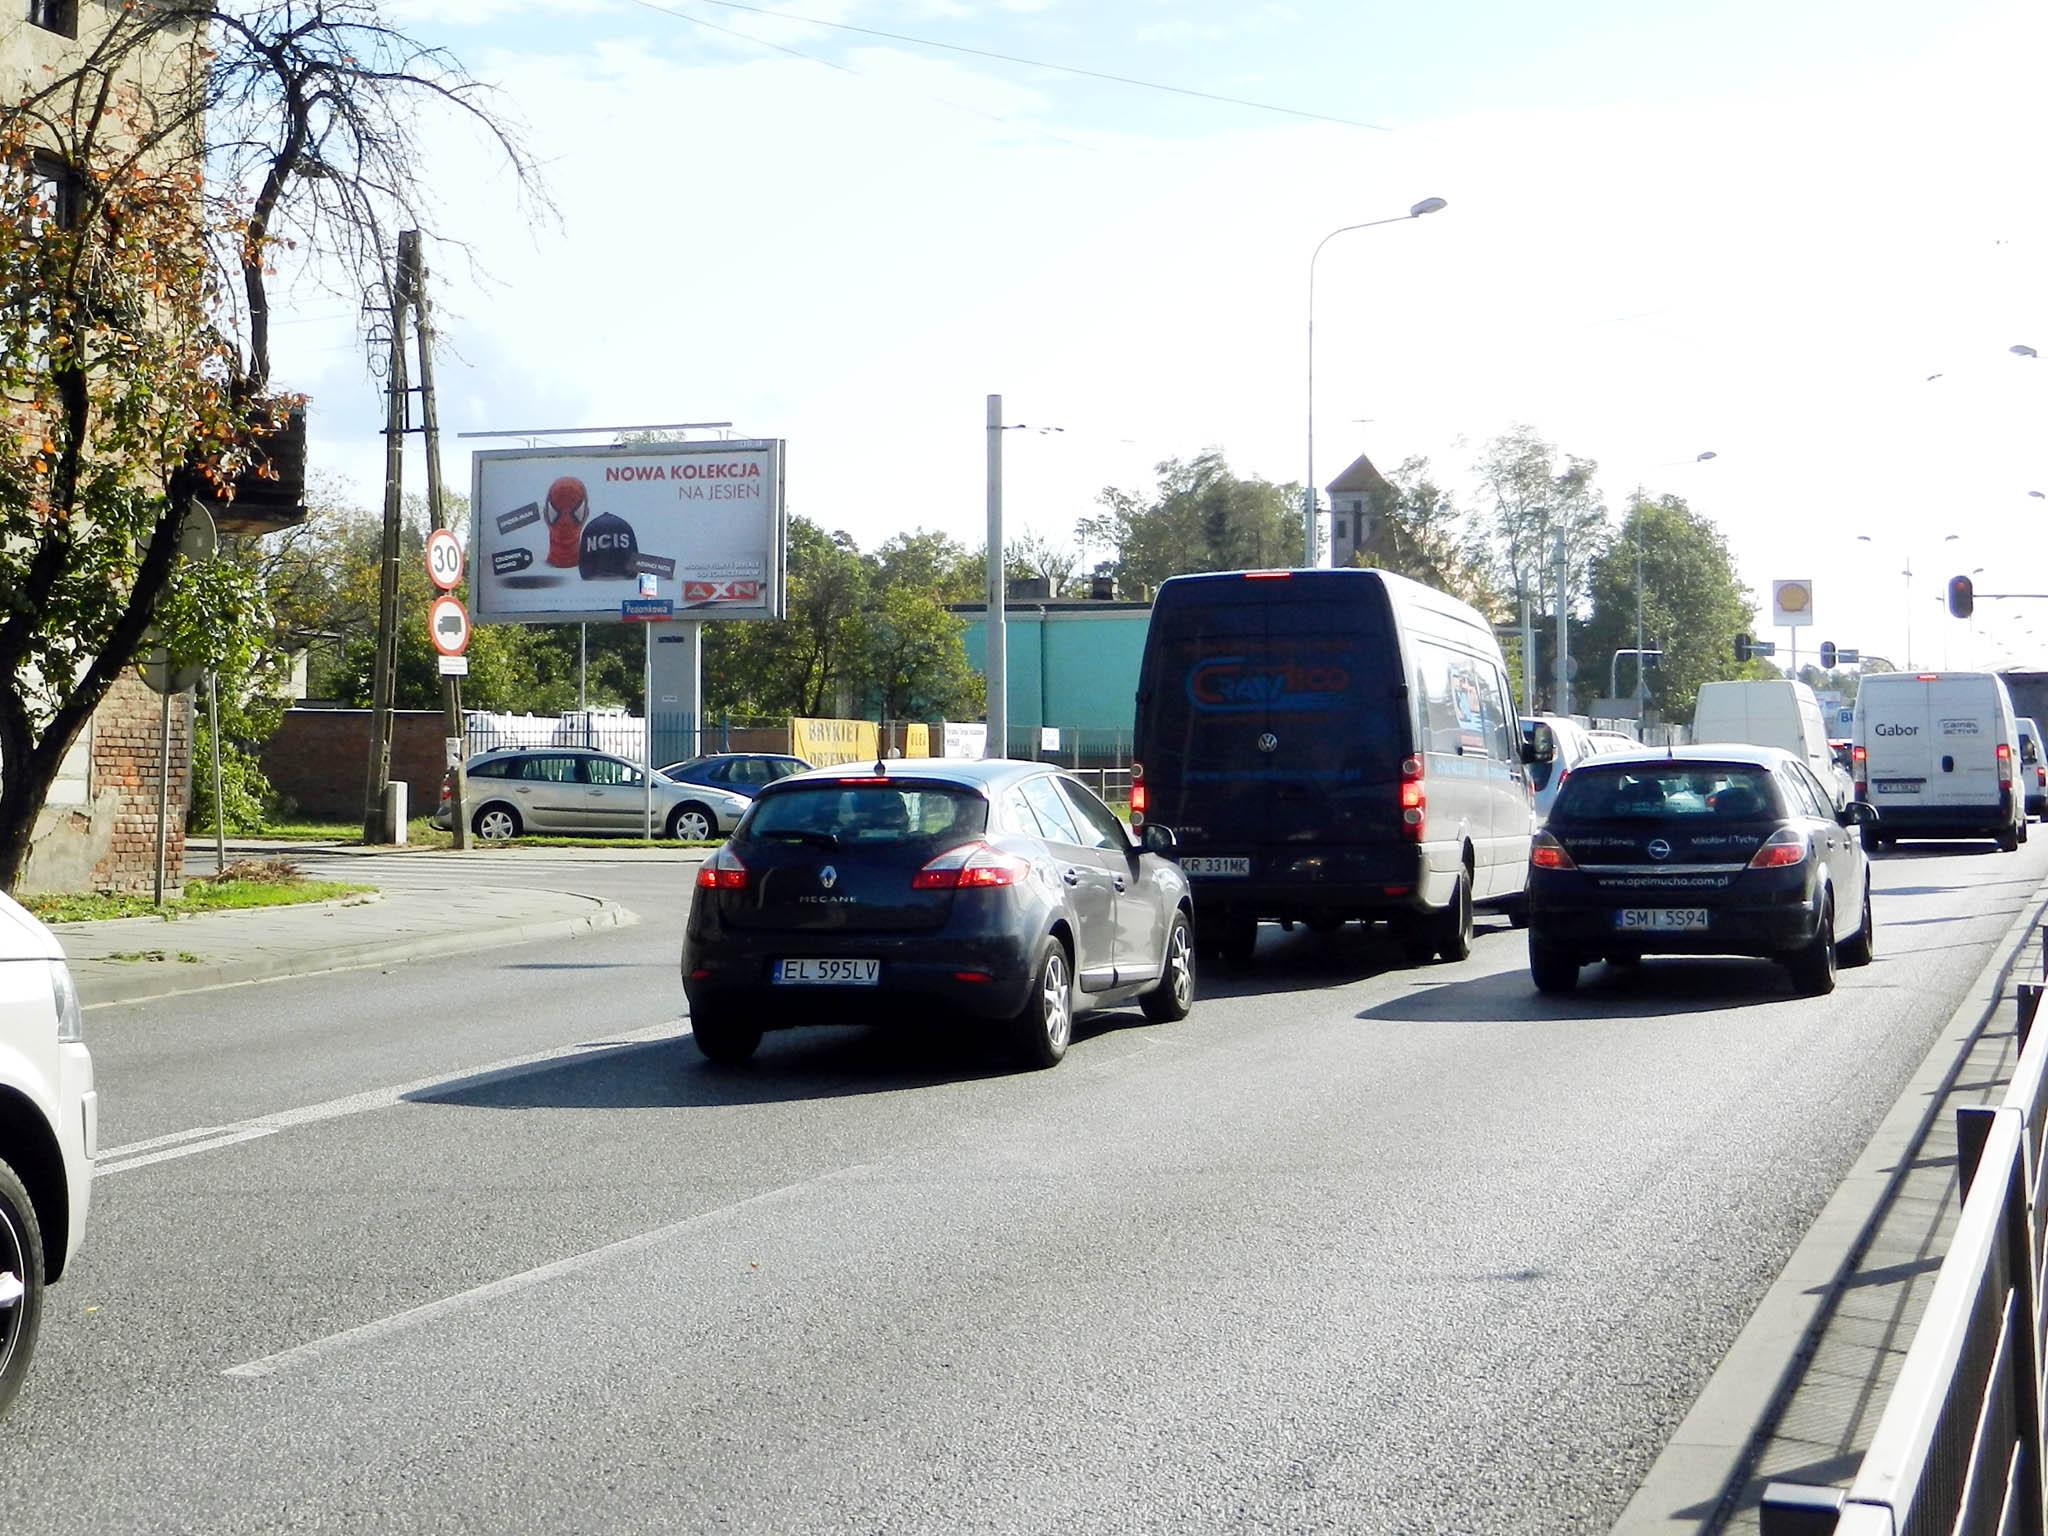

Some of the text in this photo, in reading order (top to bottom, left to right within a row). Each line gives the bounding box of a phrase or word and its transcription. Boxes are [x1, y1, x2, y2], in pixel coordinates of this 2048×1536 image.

[605, 462, 761, 482] NOWA KOLEKCJA
[678, 479, 760, 500] NA JESIEŃ
[586, 533, 630, 552] NCIS
[433, 545, 458, 573] 30
[687, 582, 754, 600] AXN
[1875, 724, 1919, 736] Gabor
[1181, 859, 1247, 872] KR 331MK
[1625, 911, 1656, 926] SMI
[784, 961, 877, 979] EL 595LV
